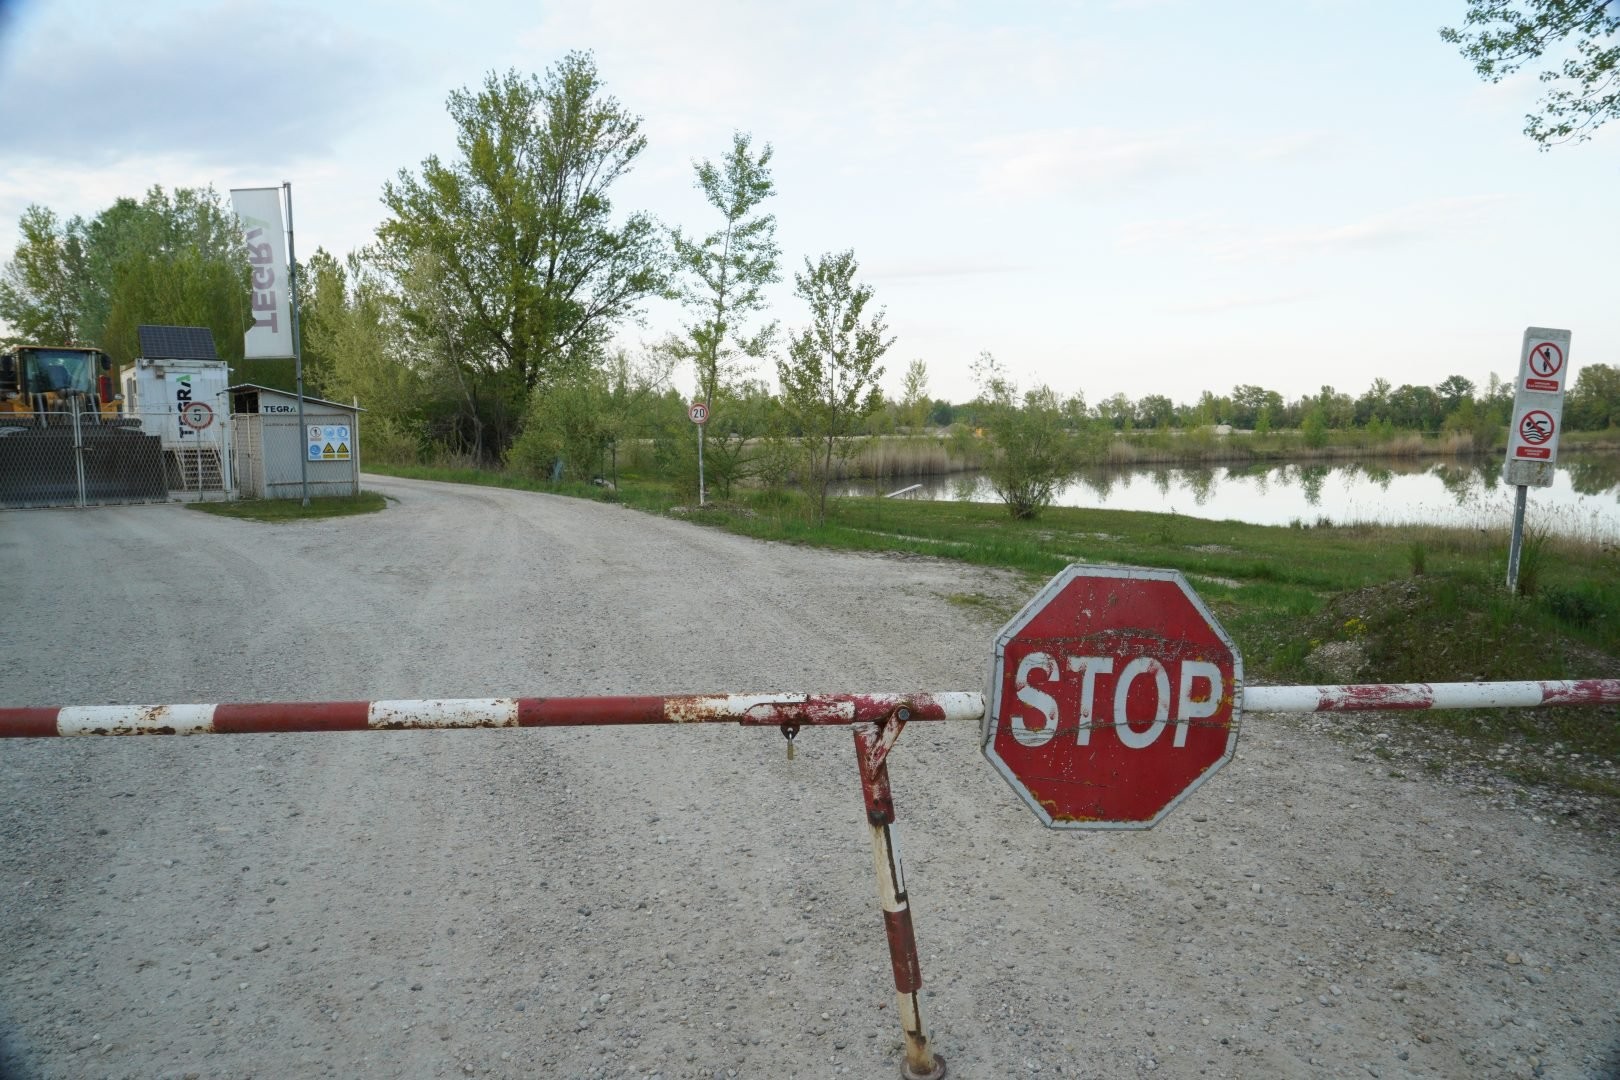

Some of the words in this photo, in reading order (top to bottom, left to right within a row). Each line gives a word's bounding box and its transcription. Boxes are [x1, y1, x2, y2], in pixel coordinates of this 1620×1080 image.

[193, 408, 201, 421] 5
[264, 405, 297, 413] TEGRA
[693, 408, 705, 418] 20
[1011, 652, 1223, 749] STOP
